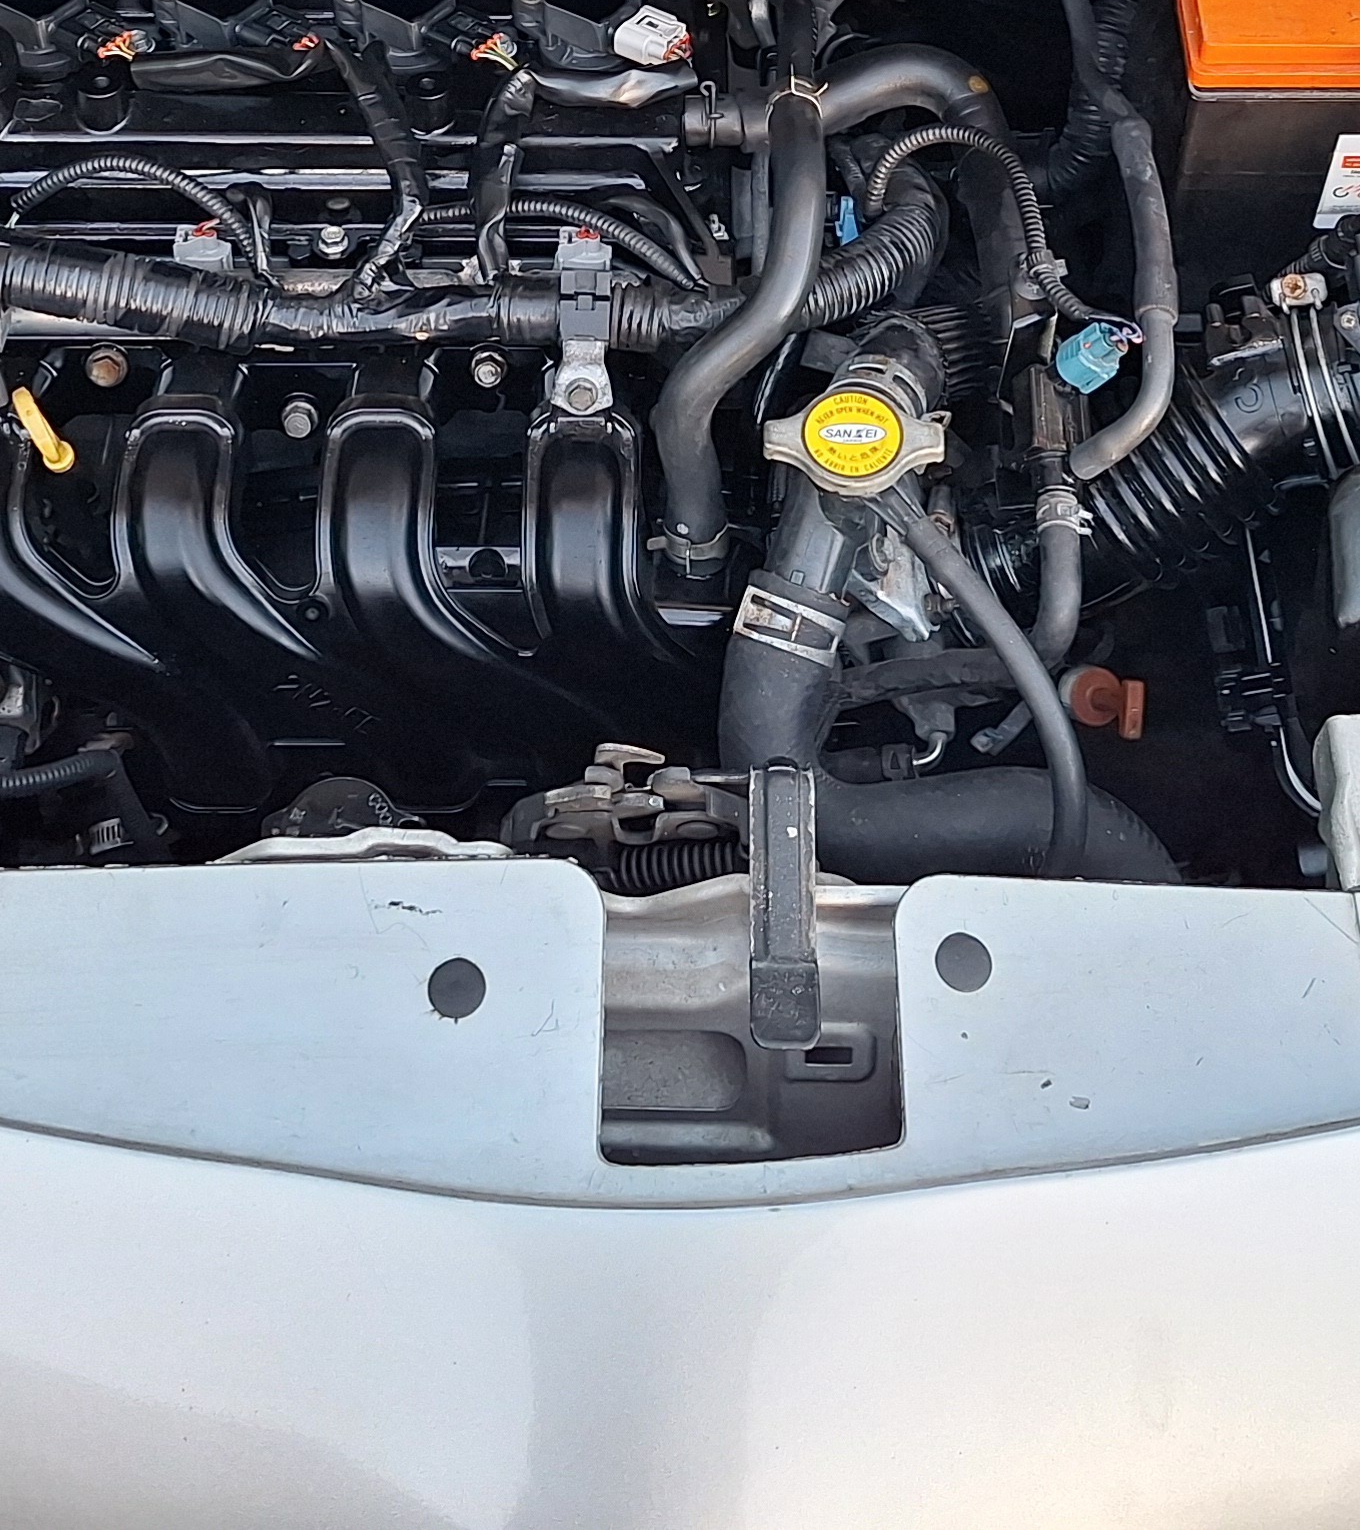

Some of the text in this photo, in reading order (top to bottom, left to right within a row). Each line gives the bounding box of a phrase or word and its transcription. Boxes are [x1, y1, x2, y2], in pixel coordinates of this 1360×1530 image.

[833, 395, 869, 405] CAUTION
[815, 410, 835, 424] NEVER
[835, 406, 853, 414] OPEN
[855, 406, 875, 417] WHEN
